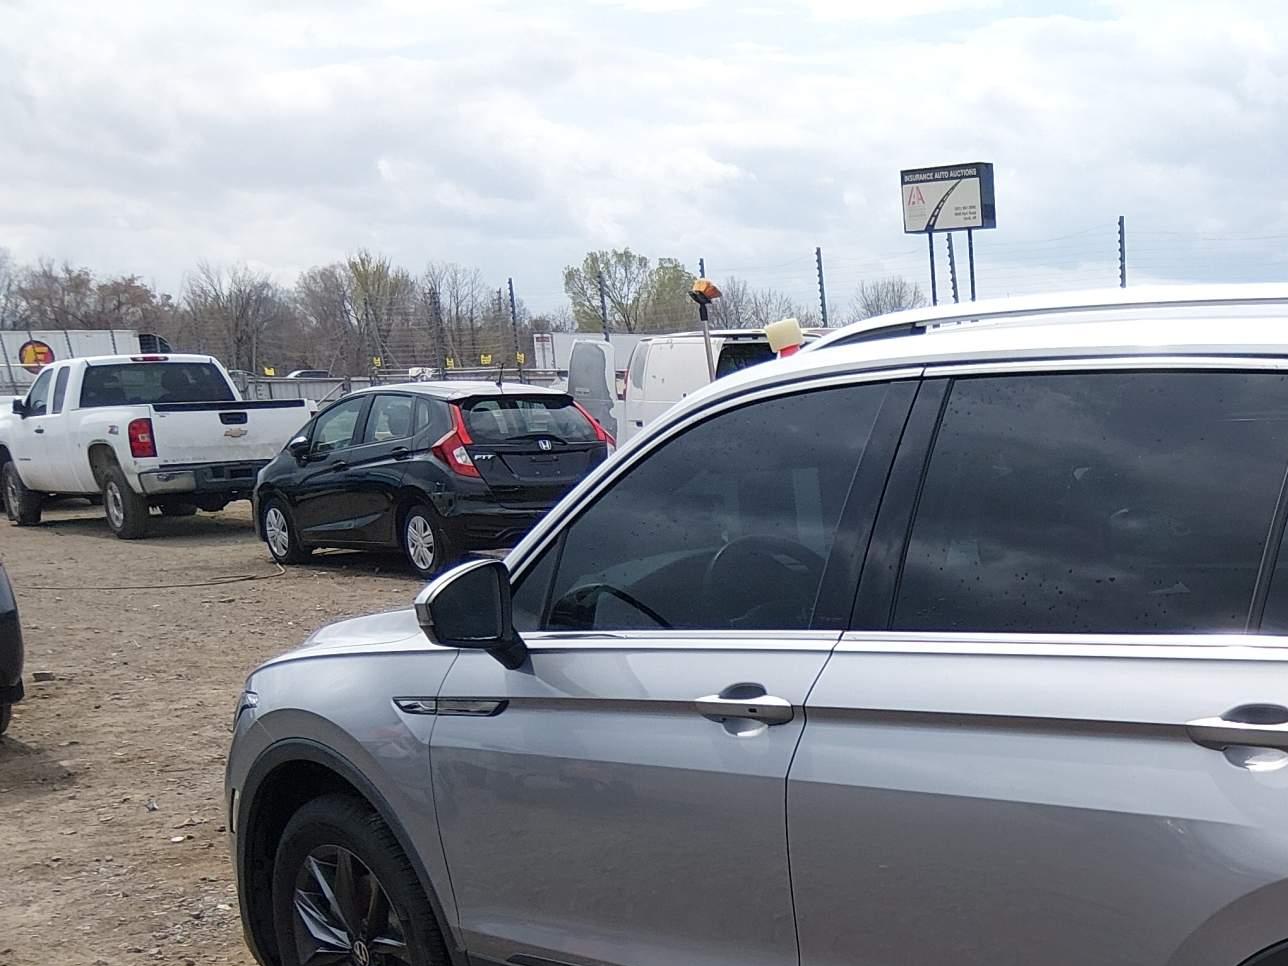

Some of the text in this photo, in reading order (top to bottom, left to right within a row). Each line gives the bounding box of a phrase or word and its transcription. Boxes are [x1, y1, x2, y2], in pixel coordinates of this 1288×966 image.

[904, 168, 977, 182] INSURANCE AUTO AUCTIONS
